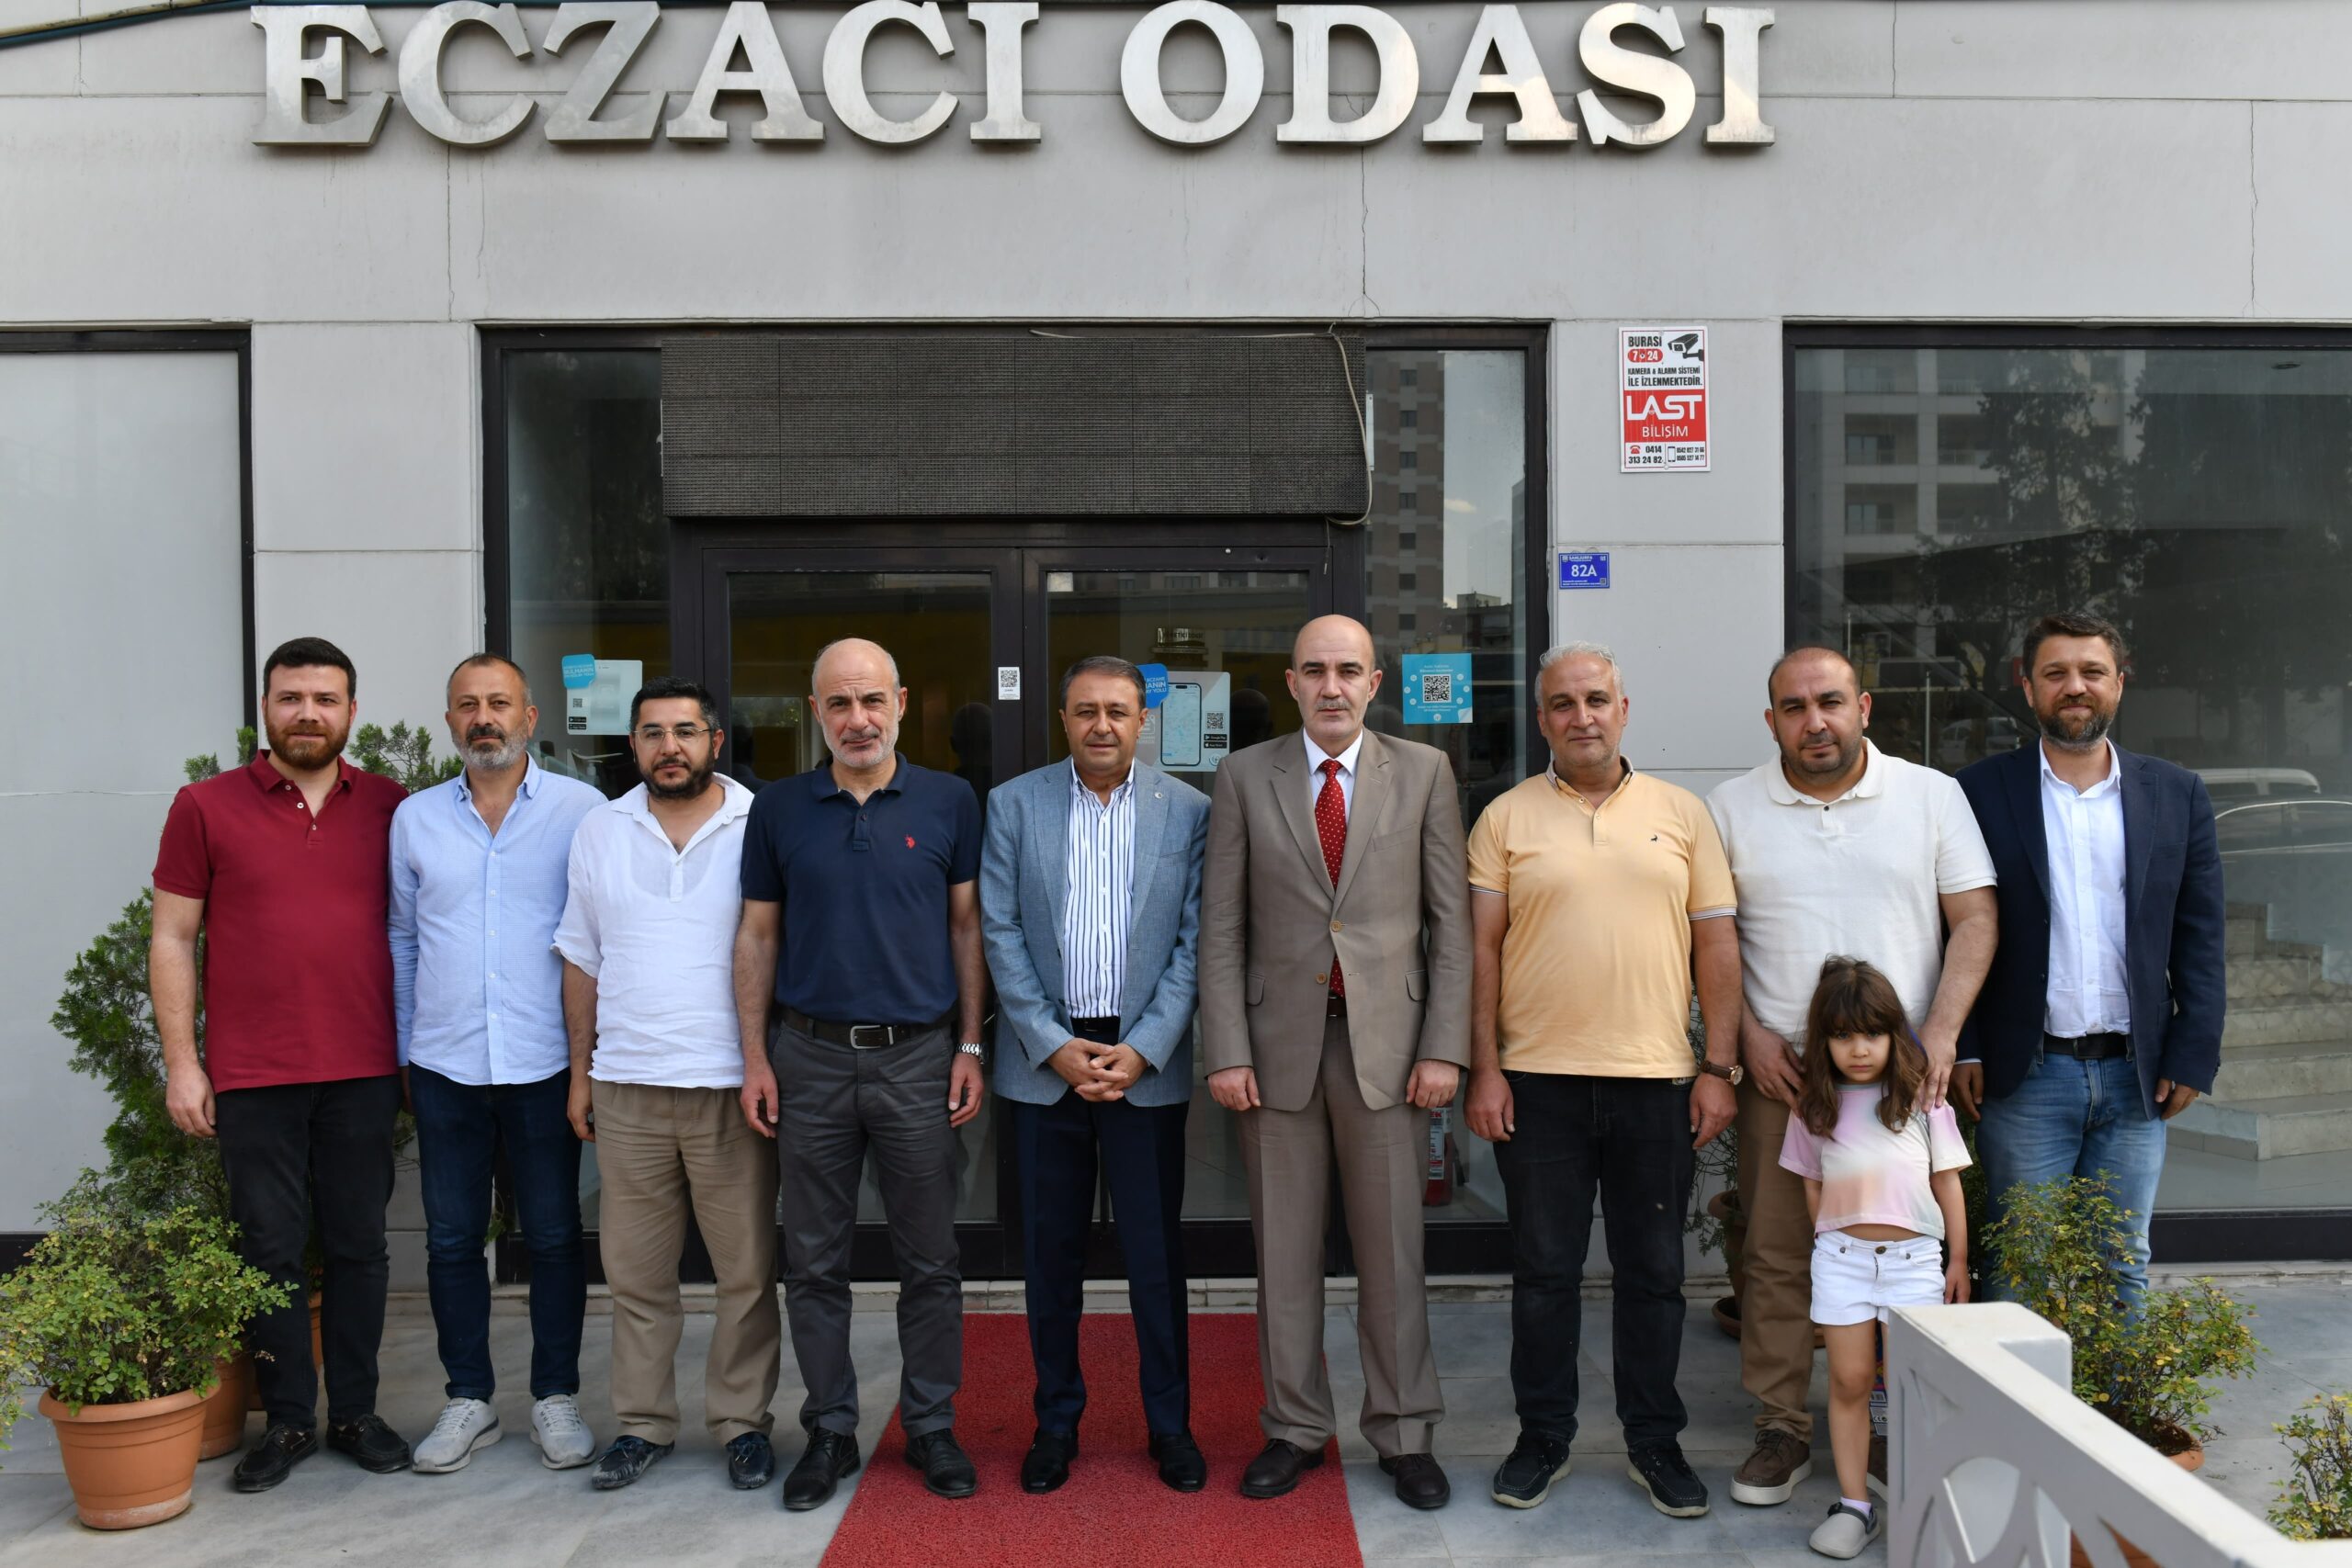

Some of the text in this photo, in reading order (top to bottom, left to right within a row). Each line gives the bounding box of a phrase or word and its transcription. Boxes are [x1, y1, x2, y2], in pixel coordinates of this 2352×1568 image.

[251, 0, 1775, 146] ECZACI ODASI
[1628, 336, 1662, 347] BURASI
[1678, 366, 1701, 375] SİSTEMİ
[1628, 376, 1640, 387] İLE
[1626, 395, 1702, 421] LAST
[1642, 424, 1689, 438] BİLİŞİM
[1628, 456, 1640, 464] 313
[1643, 456, 1651, 464] 24
[1571, 564, 1597, 577] 82A
